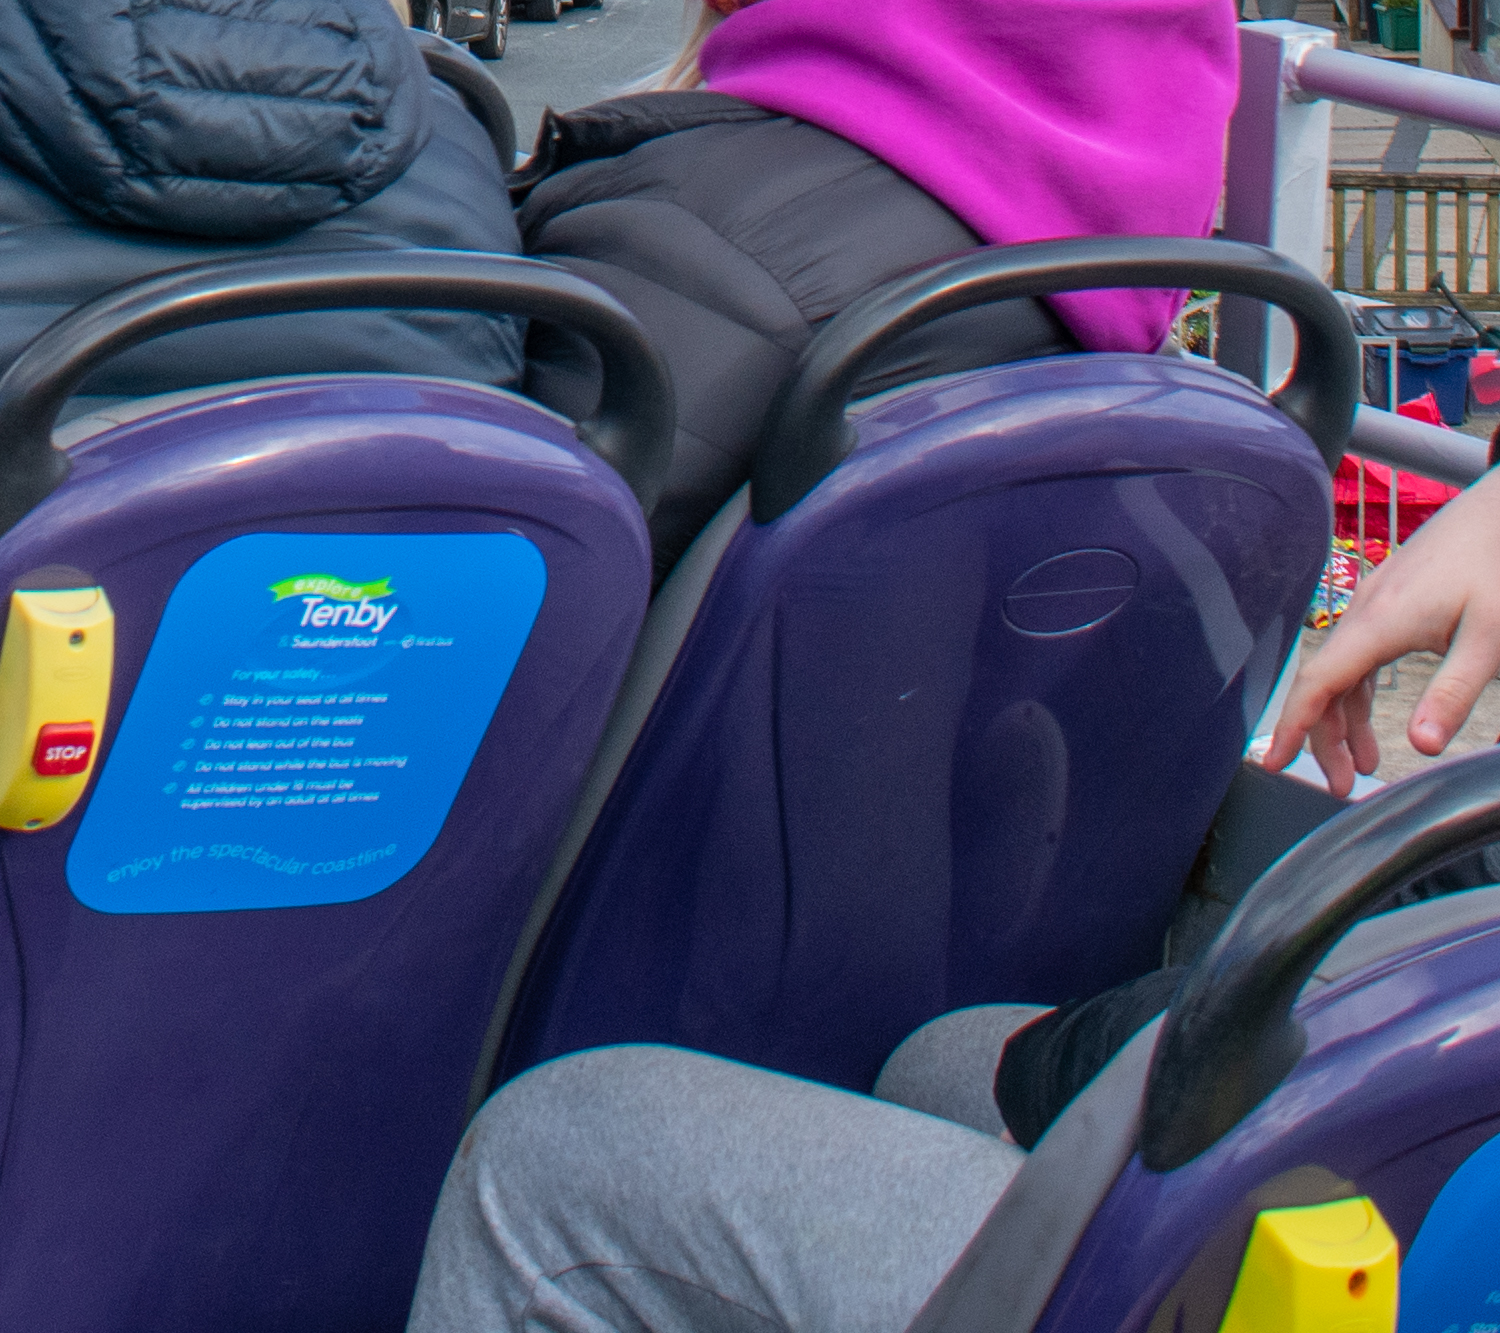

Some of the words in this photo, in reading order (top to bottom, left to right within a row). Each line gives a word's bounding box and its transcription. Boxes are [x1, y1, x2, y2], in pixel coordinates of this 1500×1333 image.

[293, 578, 363, 598] explore
[301, 595, 398, 633] Tenby
[232, 670, 252, 680] For
[253, 670, 281, 683] your
[223, 694, 250, 707] Stay
[251, 694, 264, 705] in
[265, 695, 294, 708] your
[295, 694, 323, 705] seat
[324, 694, 337, 705] at
[339, 693, 354, 704] all
[355, 693, 389, 703] times
[213, 716, 231, 729] Do
[232, 717, 254, 728] not
[255, 716, 291, 728] stand
[292, 717, 308, 727] on
[310, 715, 330, 726] the
[332, 715, 364, 726] seats
[204, 739, 222, 751] Do
[223, 739, 245, 750] not
[246, 738, 273, 750] lean
[275, 738, 296, 750] out
[297, 737, 312, 749] of
[311, 737, 331, 748] the
[332, 737, 355, 748] bus
[45, 745, 87, 761] STOP
[195, 761, 212, 773] Do
[214, 761, 236, 772] not
[237, 760, 273, 772] stand
[274, 759, 306, 771] while
[307, 758, 327, 770] the
[328, 757, 351, 769] bus
[353, 757, 362, 768] is
[364, 755, 408, 769] moving
[186, 782, 203, 794] All
[203, 781, 252, 793] children
[255, 781, 290, 793] under
[306, 780, 337, 791] must
[338, 778, 355, 790] be
[180, 796, 247, 810] supervised
[247, 796, 264, 808] by
[266, 796, 282, 806] an
[284, 794, 316, 806] adult
[317, 793, 330, 804] at
[331, 792, 346, 803] all
[347, 791, 380, 802] times
[106, 854, 165, 883] enjoy
[170, 845, 204, 863] the
[208, 844, 309, 875] spectacular
[311, 843, 397, 875] coastline
